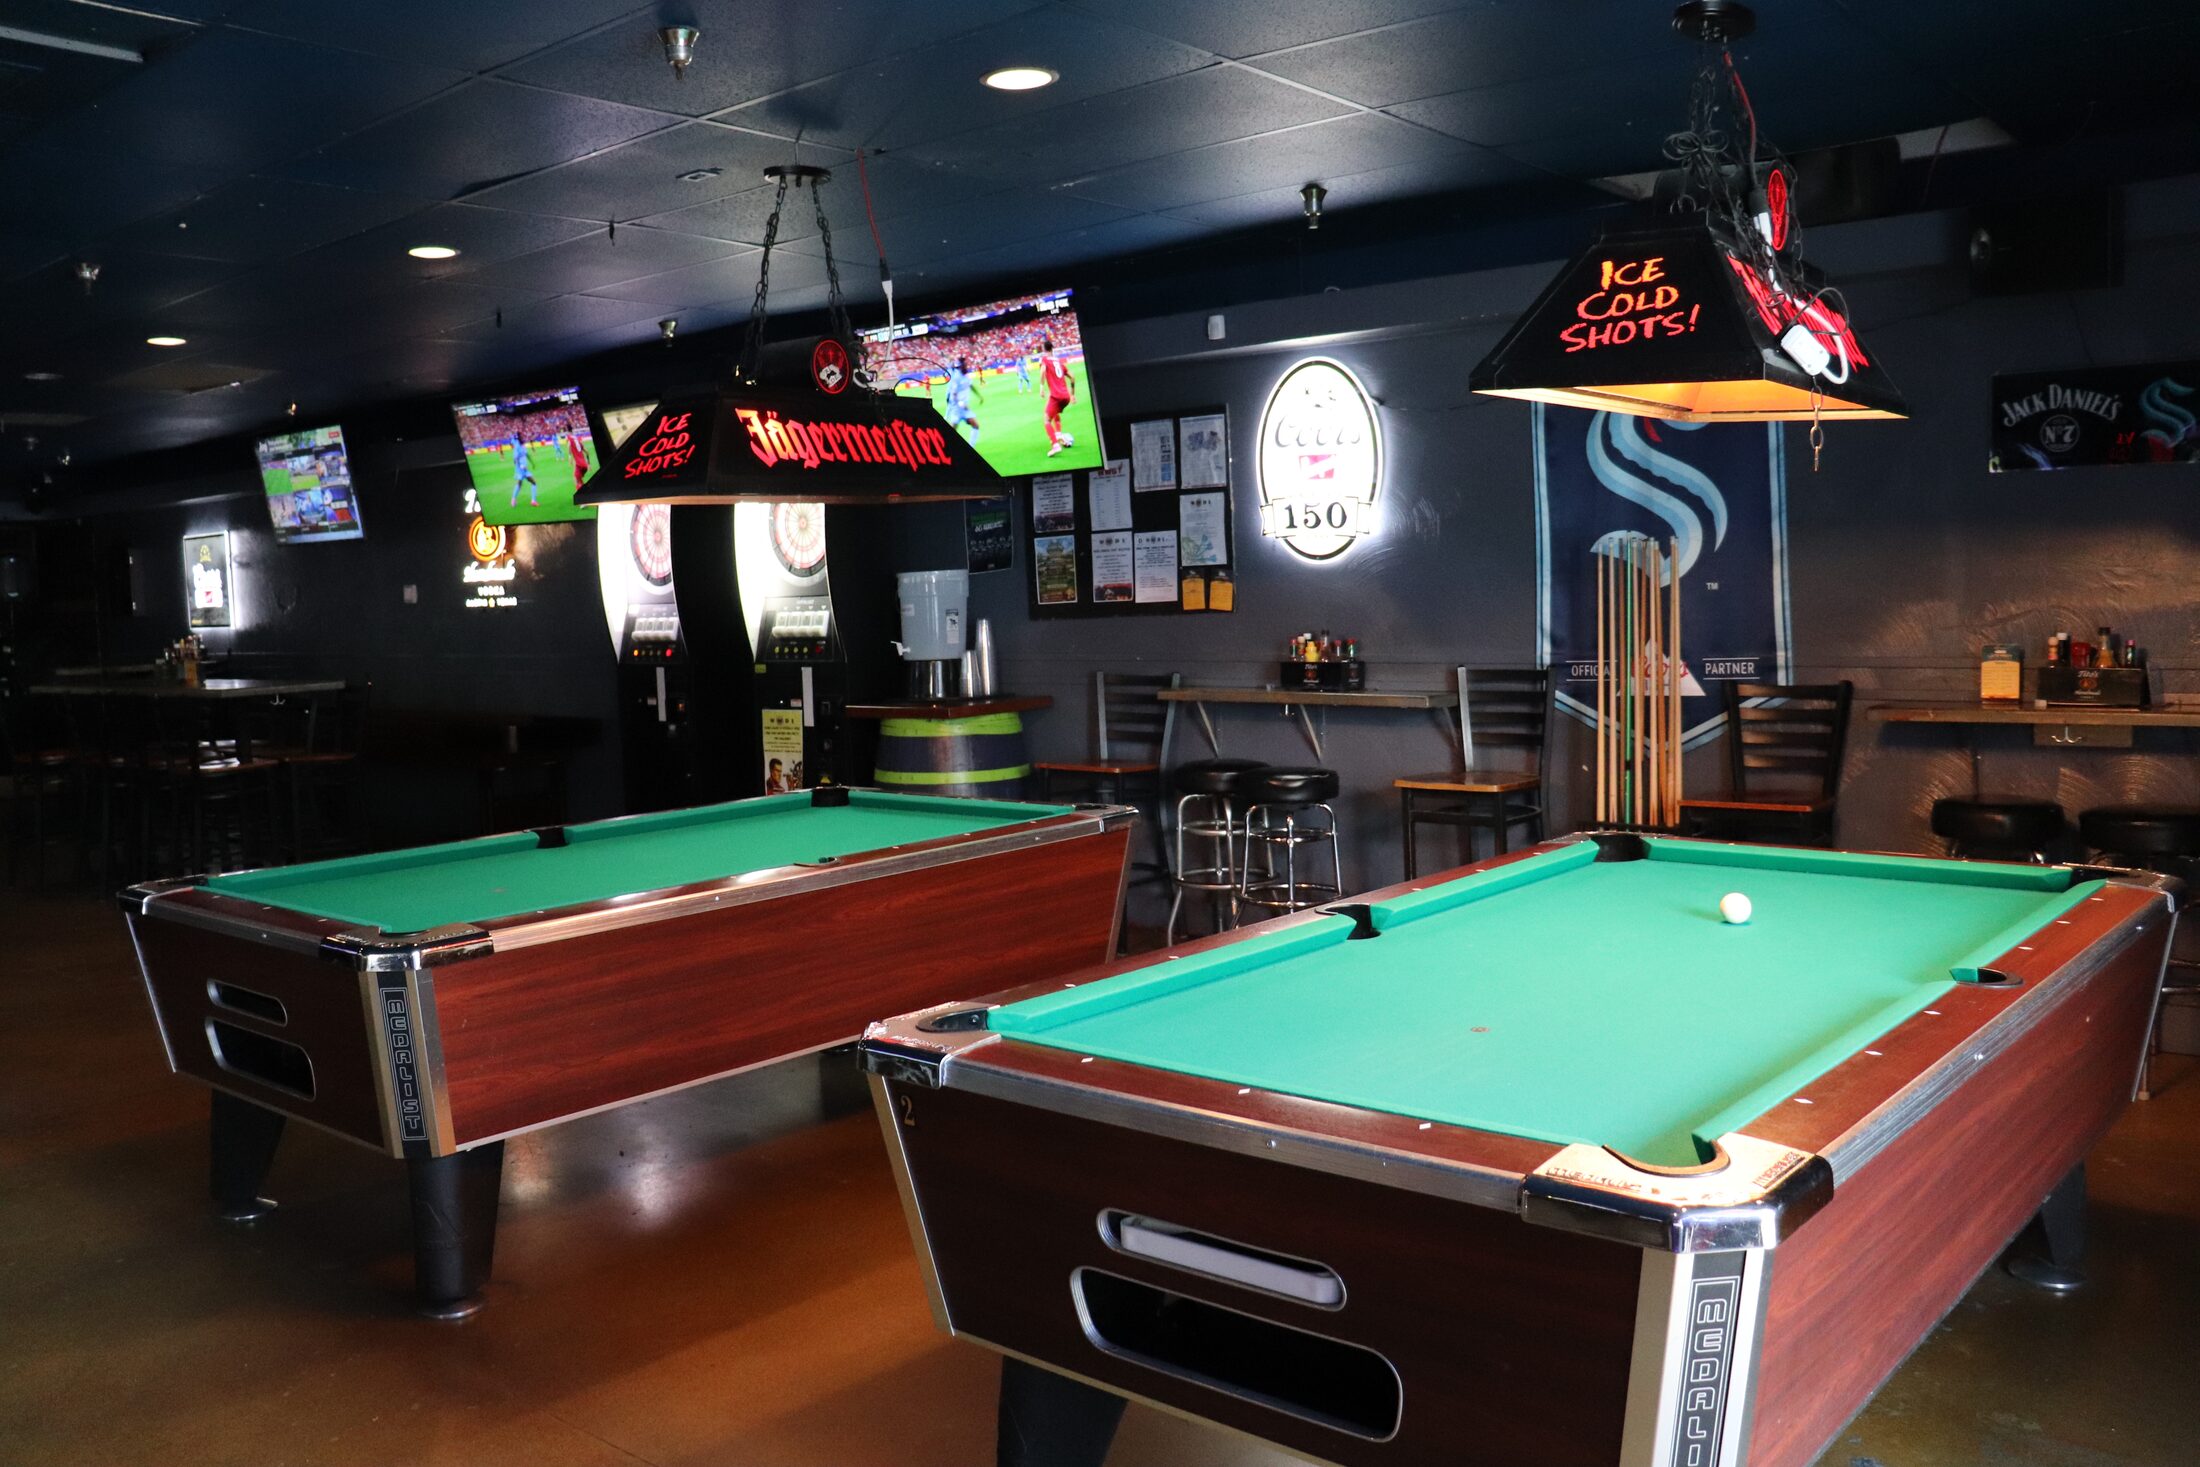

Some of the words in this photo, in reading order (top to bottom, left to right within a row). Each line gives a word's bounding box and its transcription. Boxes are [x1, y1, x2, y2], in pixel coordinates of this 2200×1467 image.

[1600, 257, 1665, 291] ICE
[1577, 286, 1679, 320] COLD
[1559, 304, 1700, 353] SHOTS!
[2001, 391, 2046, 427] JACK
[2048, 384, 2123, 421] DANIEL'S
[656, 412, 692, 435] ICE
[638, 432, 690, 457] COLD
[624, 445, 695, 479] SHOTS!
[1284, 501, 1348, 529] 150
[1706, 582, 1719, 590] TM
[1571, 664, 1614, 676] OFFICA
[1704, 662, 1755, 676] PARTNER
[387, 999, 421, 1129] MEDALIST
[901, 1095, 915, 1126] 2
